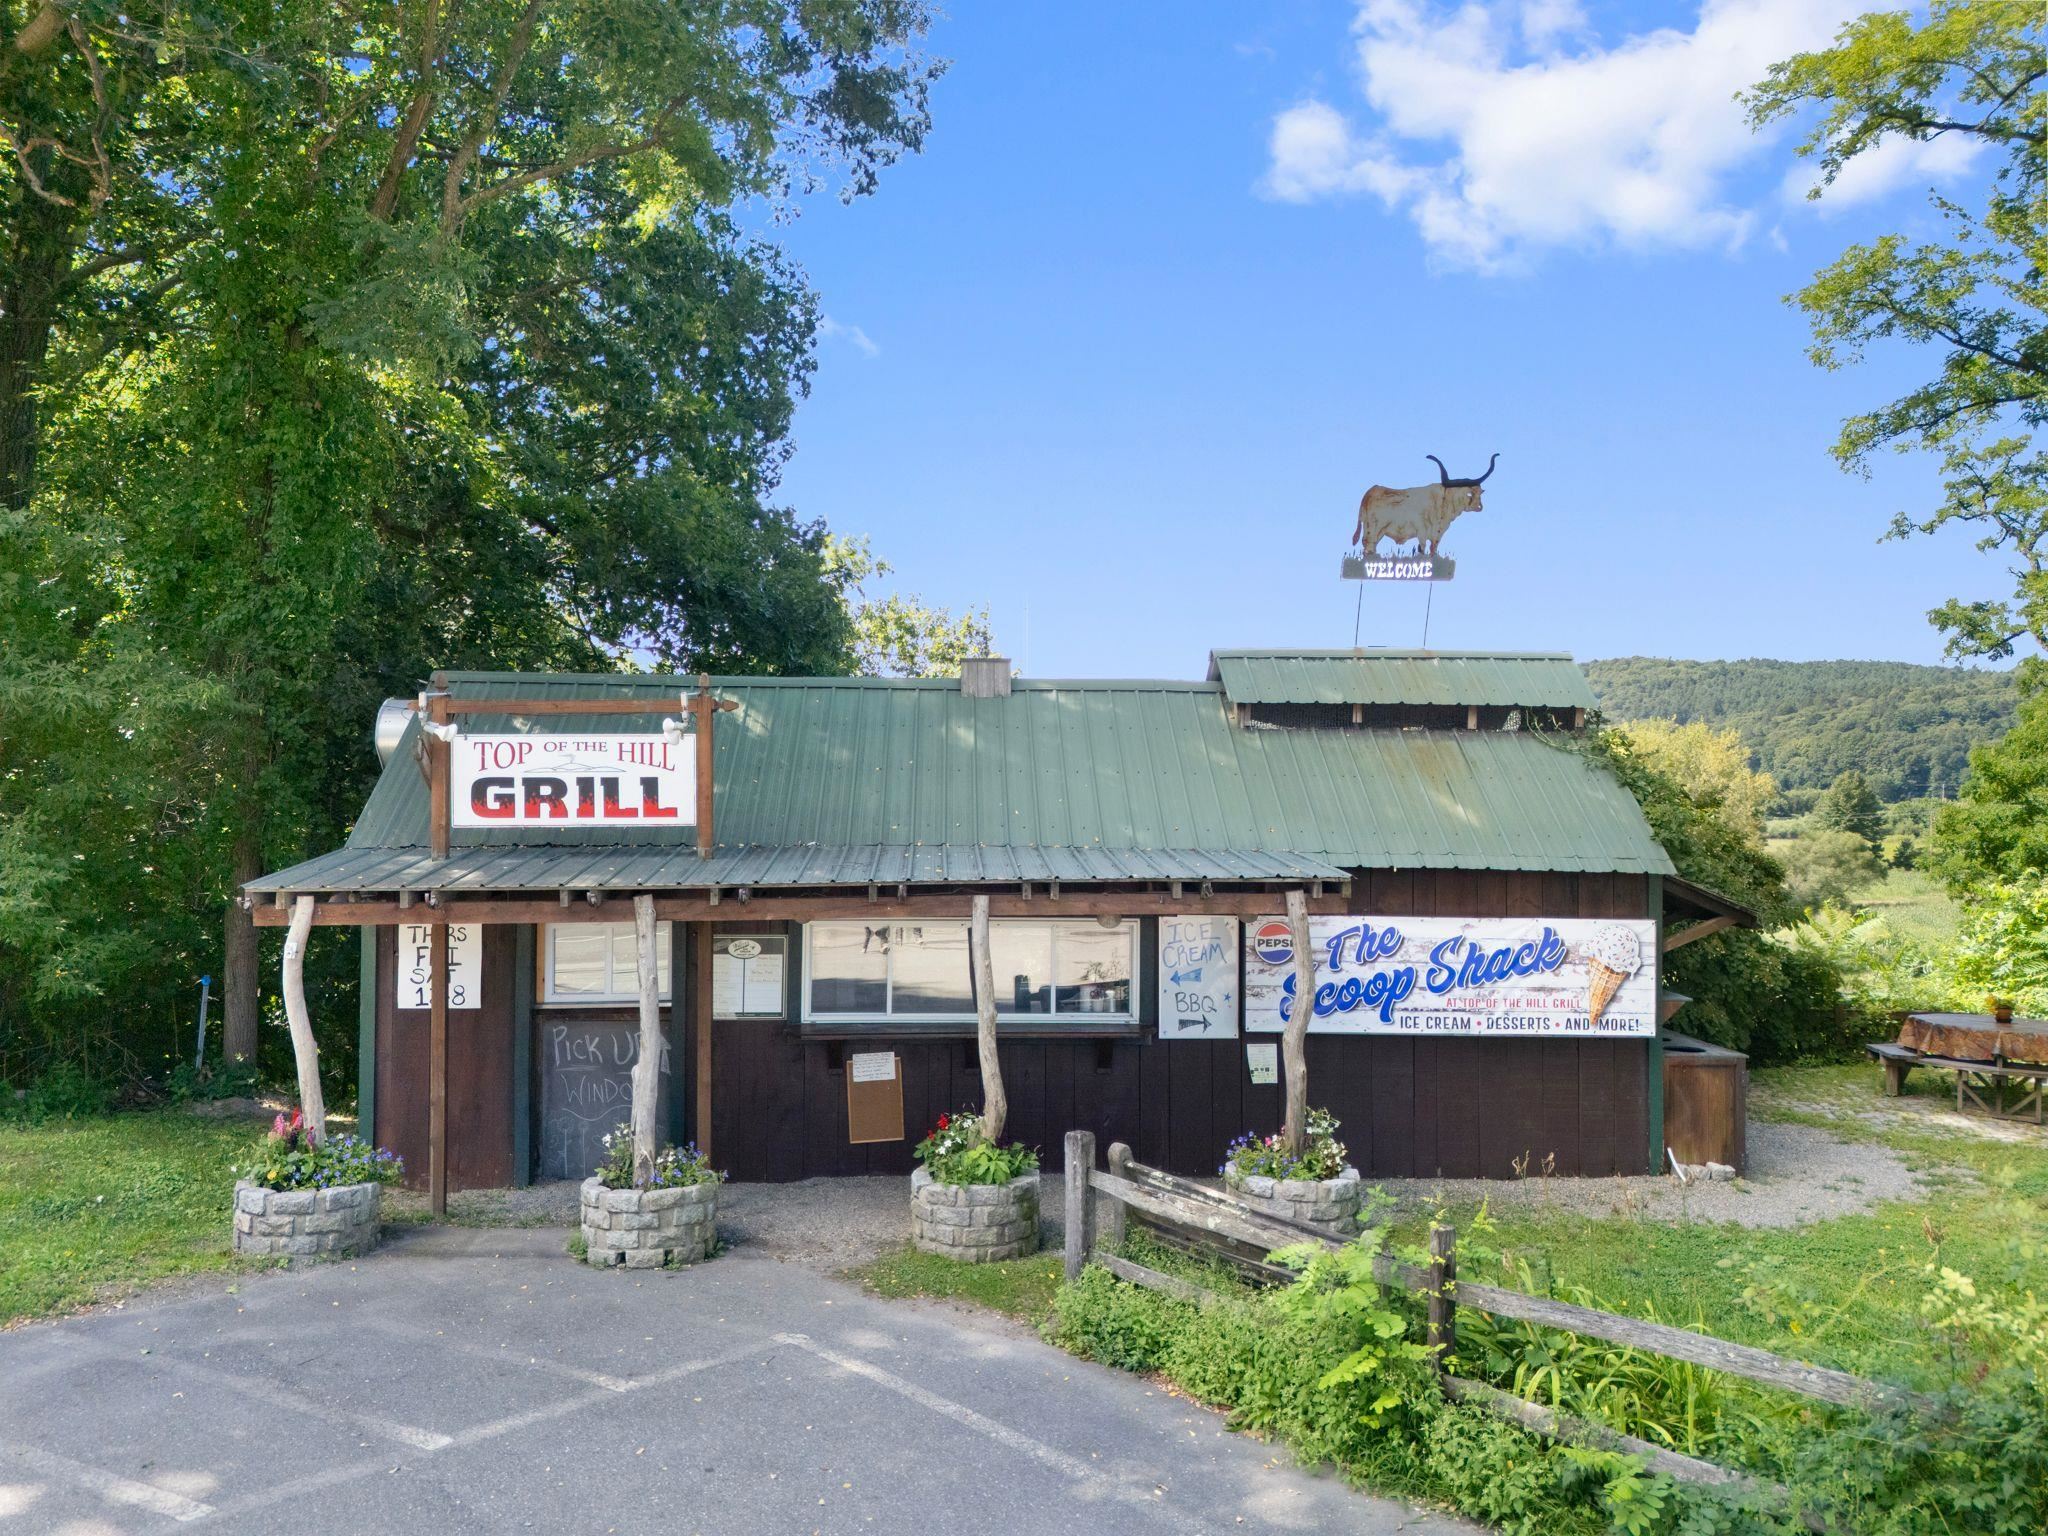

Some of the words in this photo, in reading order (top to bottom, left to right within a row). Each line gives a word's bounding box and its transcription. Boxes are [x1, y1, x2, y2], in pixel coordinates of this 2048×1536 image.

[1364, 561, 1433, 578] WELCOME
[473, 741, 533, 772] TOP
[544, 741, 568, 752] OF
[573, 741, 608, 752] THE
[618, 742, 676, 771] HILL
[470, 776, 678, 818] GRILL
[407, 925, 467, 944] THRS
[1167, 922, 1221, 945] ICE
[1257, 938, 1294, 948] PEPSI
[416, 946, 462, 967] FI
[1162, 944, 1227, 968] CREAM
[1326, 923, 1404, 971] The
[1426, 927, 1568, 995] Shack
[410, 968, 456, 985] ST
[1175, 992, 1217, 1013] BBQ
[1446, 998, 1457, 1008] AT
[1461, 998, 1480, 1008] TOP
[1486, 998, 1498, 1008] OF
[1504, 998, 1521, 1008] THE
[1526, 998, 1548, 1008] HILL
[1553, 998, 1582, 1009] GRILL
[1400, 1016, 1420, 1029] ICE
[1426, 1016, 1471, 1030] CREAM
[1486, 1016, 1550, 1030] DESSERTS
[1565, 1017, 1590, 1031] AND
[1599, 1018, 1640, 1032] MORE!
[552, 1025, 603, 1066] PICK
[560, 1074, 633, 1105] WINDO
